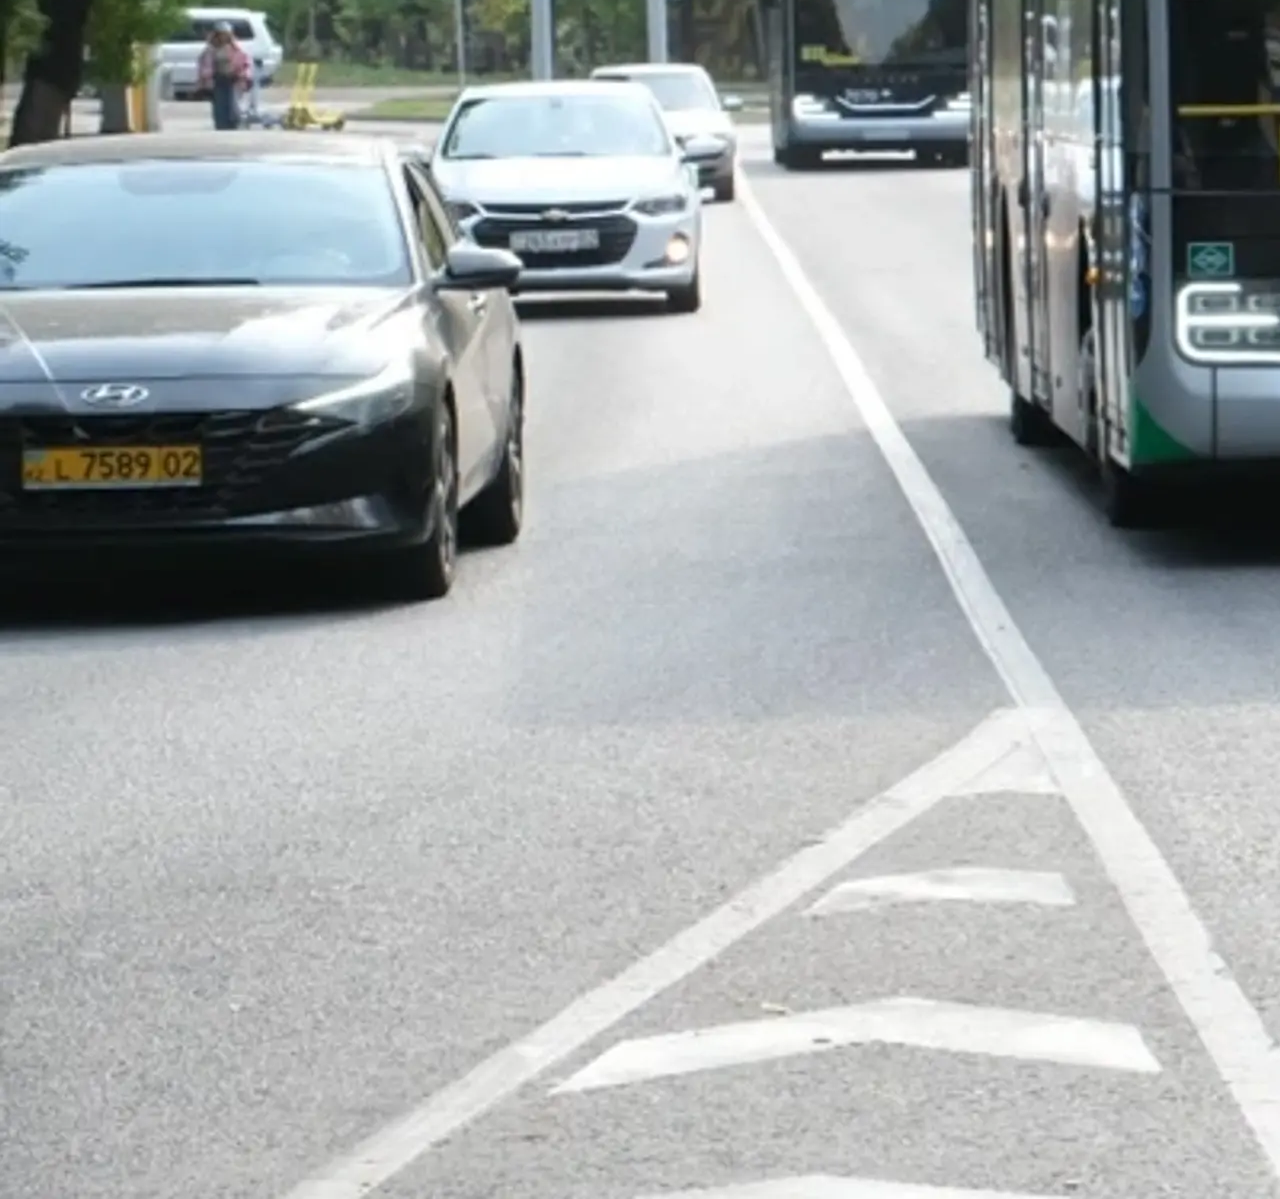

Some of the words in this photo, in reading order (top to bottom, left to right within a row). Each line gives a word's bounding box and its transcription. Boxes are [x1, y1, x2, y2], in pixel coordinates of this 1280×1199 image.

[54, 457, 70, 480] L
[79, 452, 152, 479] 7589
[163, 451, 199, 478] 02
